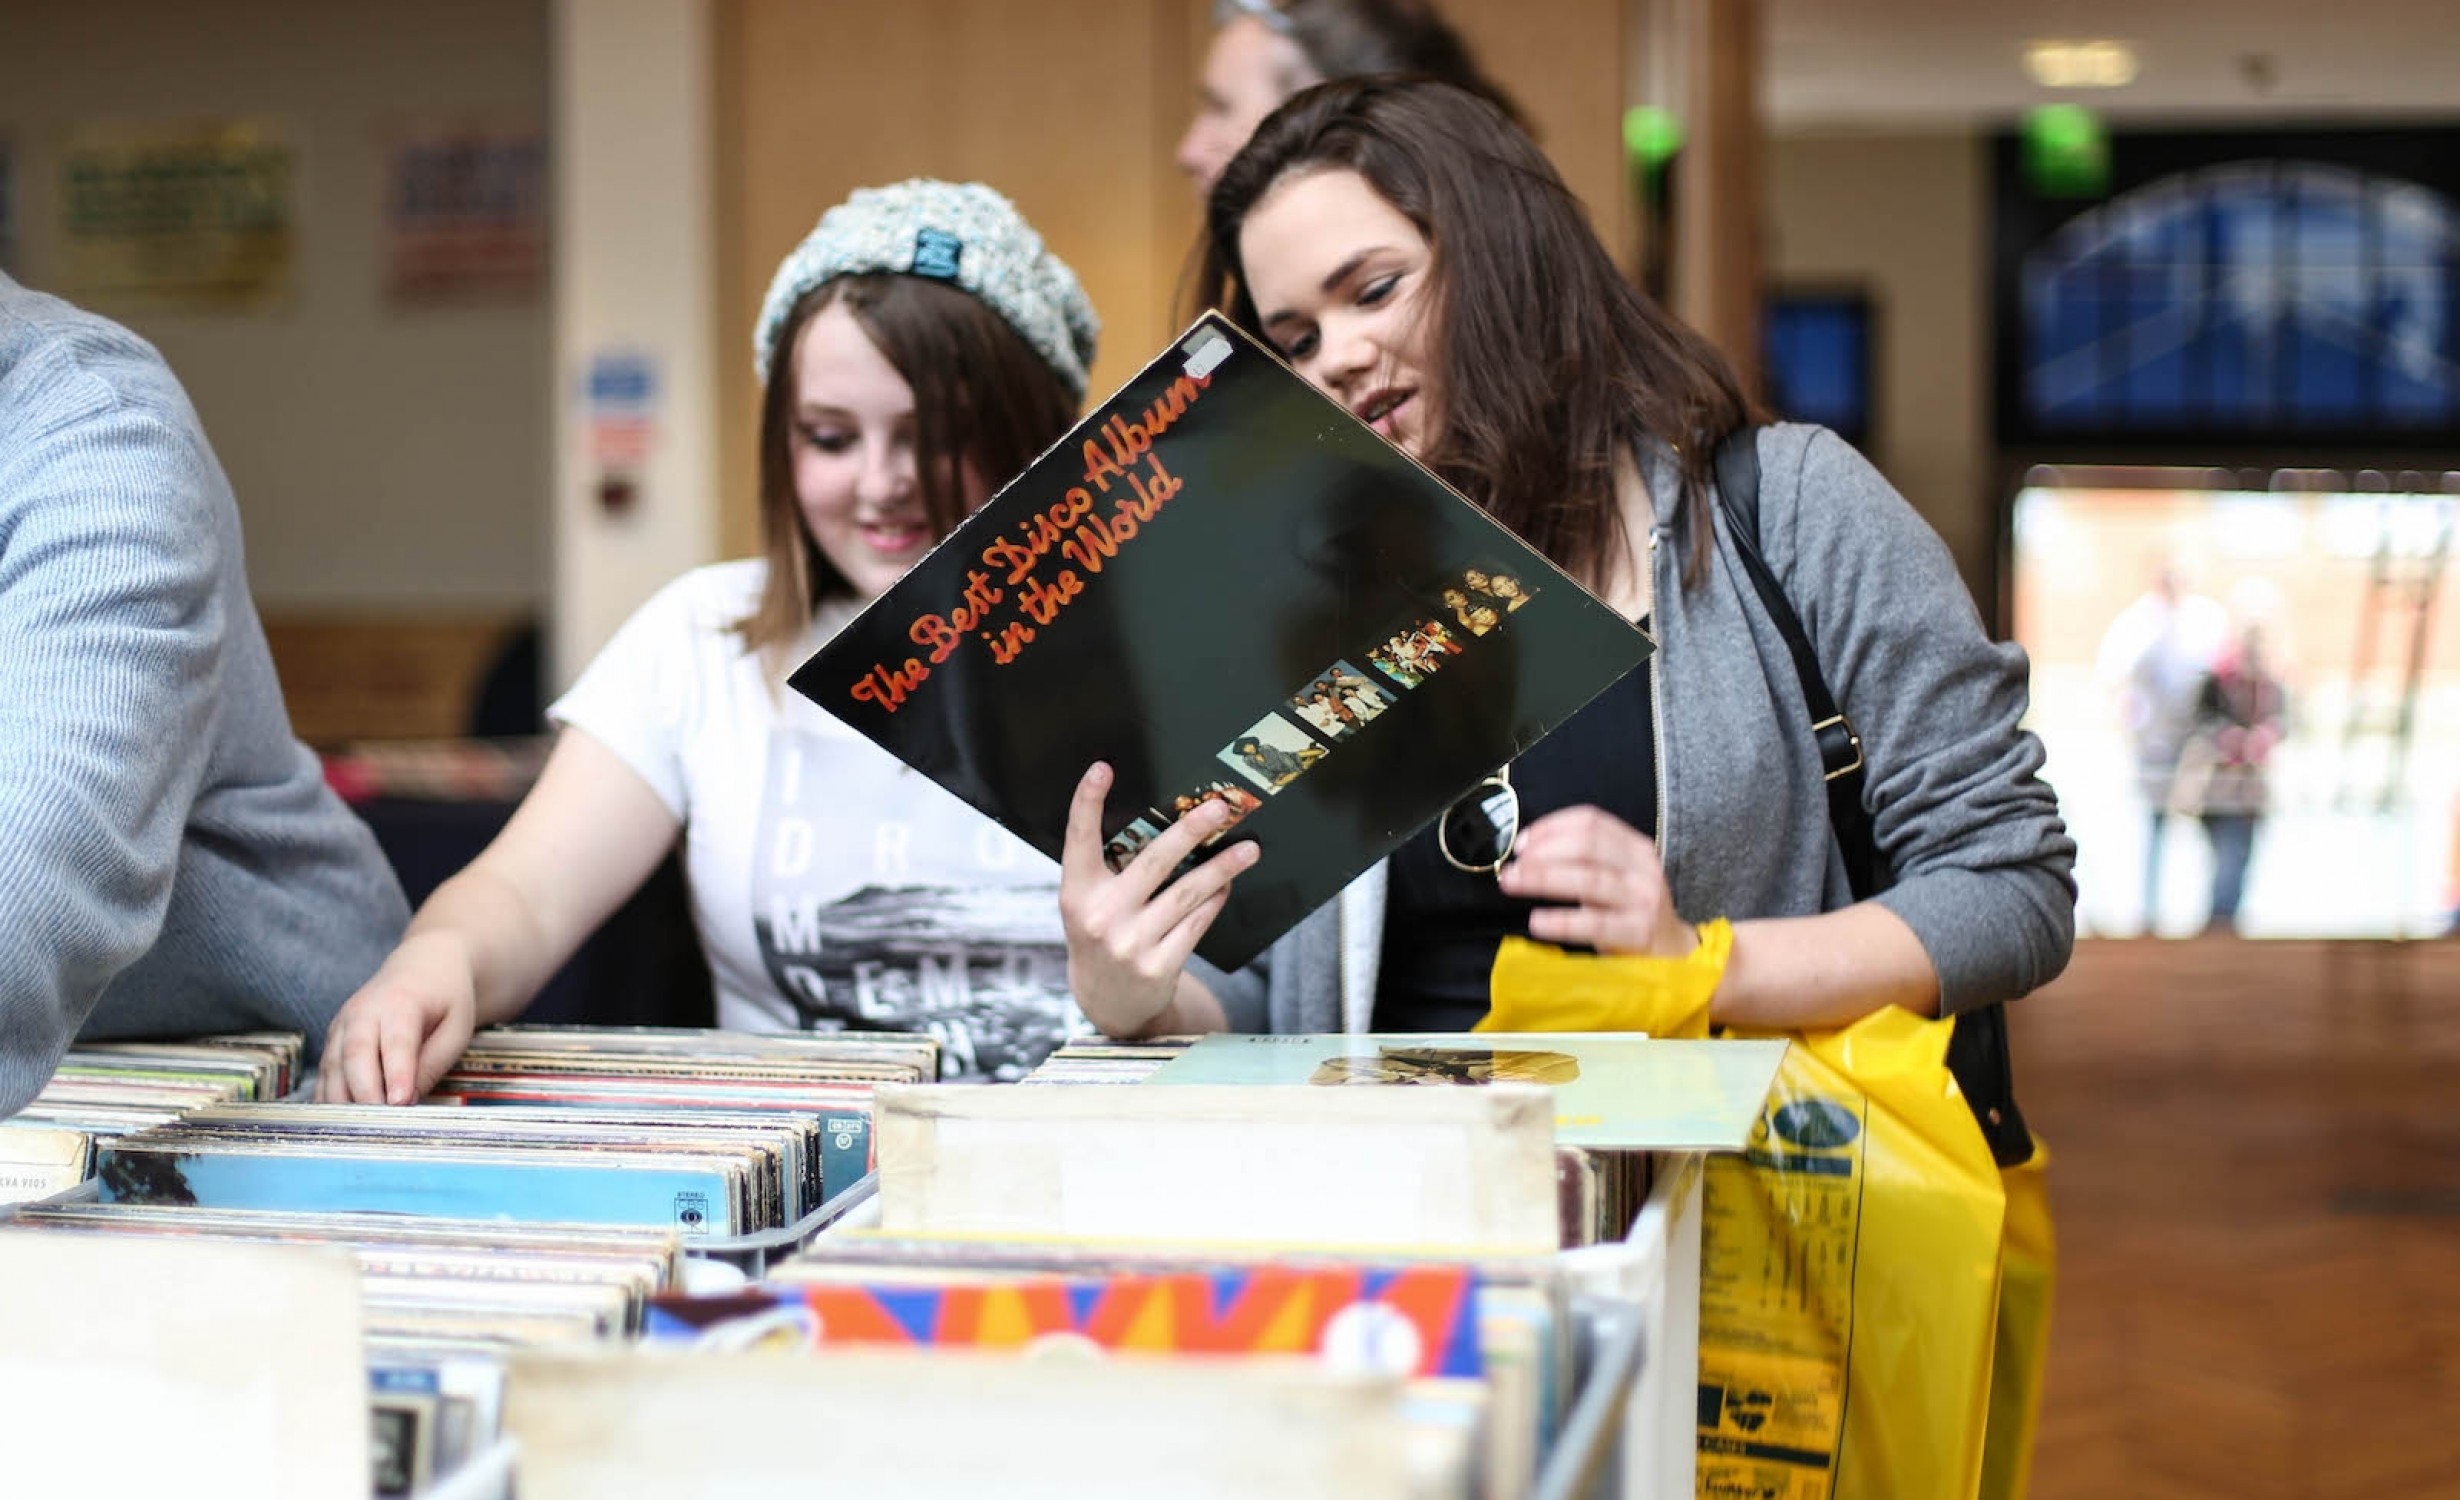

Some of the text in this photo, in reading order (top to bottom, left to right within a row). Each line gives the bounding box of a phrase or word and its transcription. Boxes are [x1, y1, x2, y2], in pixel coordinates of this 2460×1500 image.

[851, 373, 1212, 713] The Best Disco Album
[981, 453, 1183, 664] in the World
[678, 1199, 706, 1210] CBS
